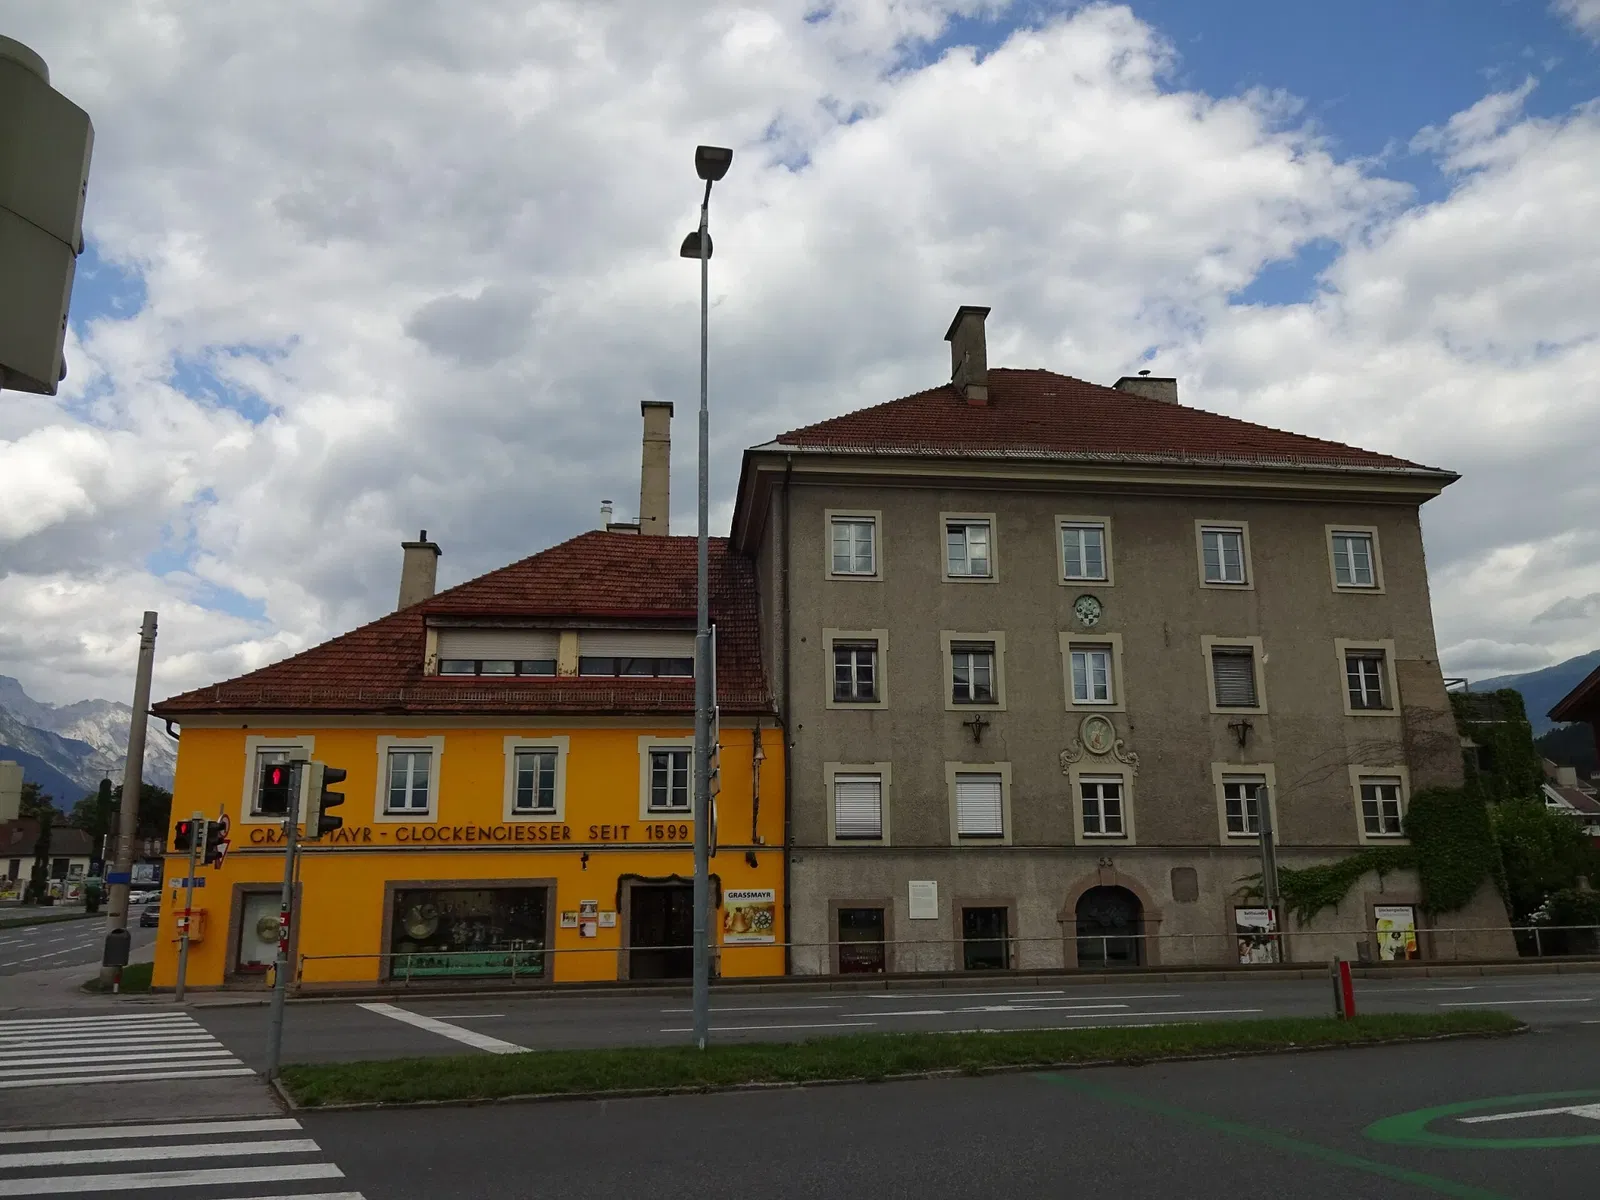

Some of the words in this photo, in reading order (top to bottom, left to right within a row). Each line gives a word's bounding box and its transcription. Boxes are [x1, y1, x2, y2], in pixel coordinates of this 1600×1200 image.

[395, 825, 572, 842] GLOCKENGIESSER
[588, 824, 631, 841] SEIT
[645, 824, 689, 840] 1599
[1099, 857, 1114, 867] 53
[728, 891, 771, 899] GRASSMAYR
